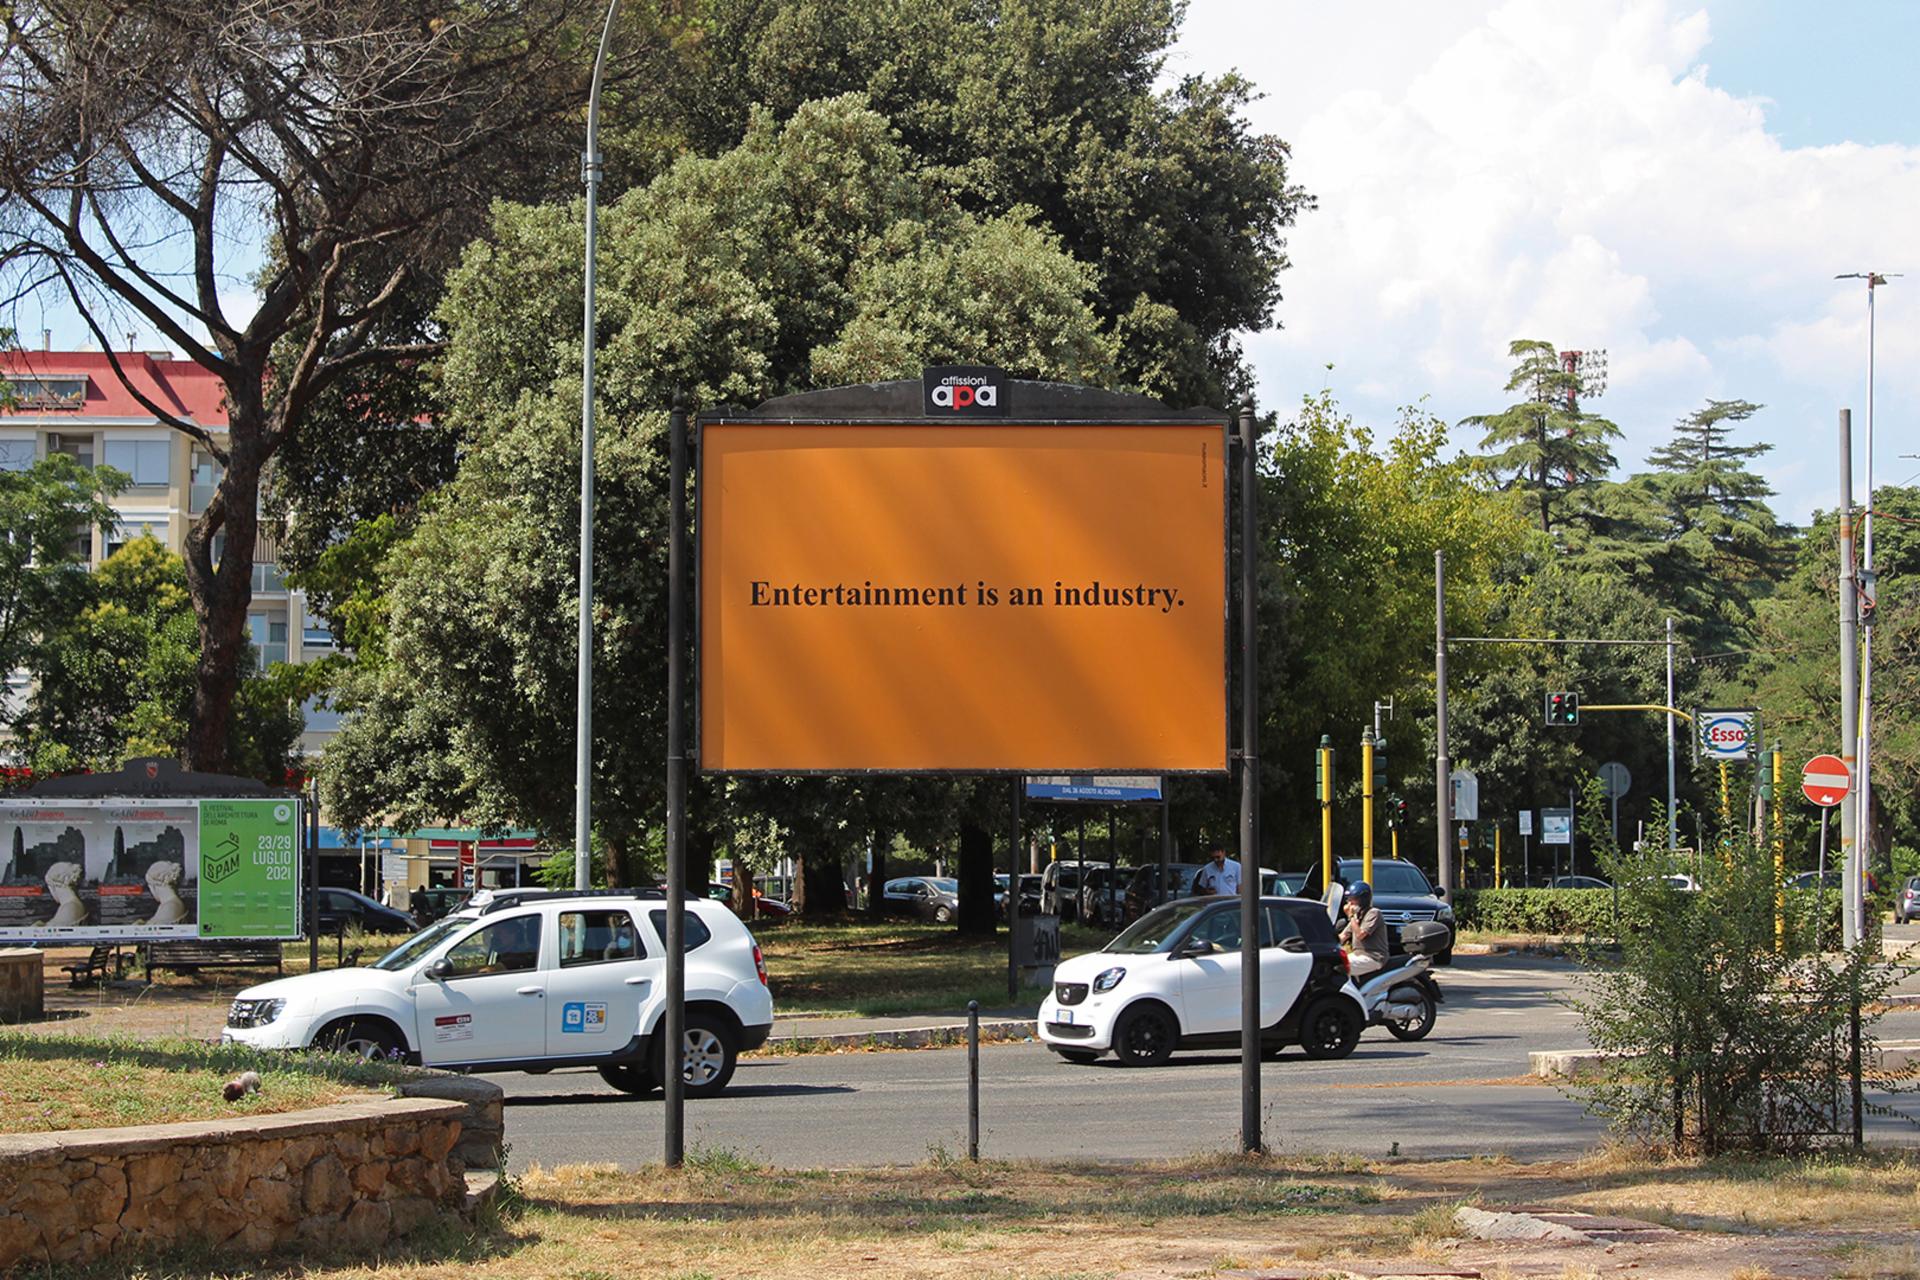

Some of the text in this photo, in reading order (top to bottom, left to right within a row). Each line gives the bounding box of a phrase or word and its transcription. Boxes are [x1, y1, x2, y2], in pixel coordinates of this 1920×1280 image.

[941, 376, 987, 386] affissioni
[931, 385, 997, 411] apa
[750, 580, 1185, 613] Entertainment is an industry.
[1711, 727, 1744, 742] Esso
[258, 835, 291, 849] 23/29
[253, 850, 291, 865] LUGLIO
[207, 854, 240, 879] SPAM
[266, 866, 291, 880] 2021
